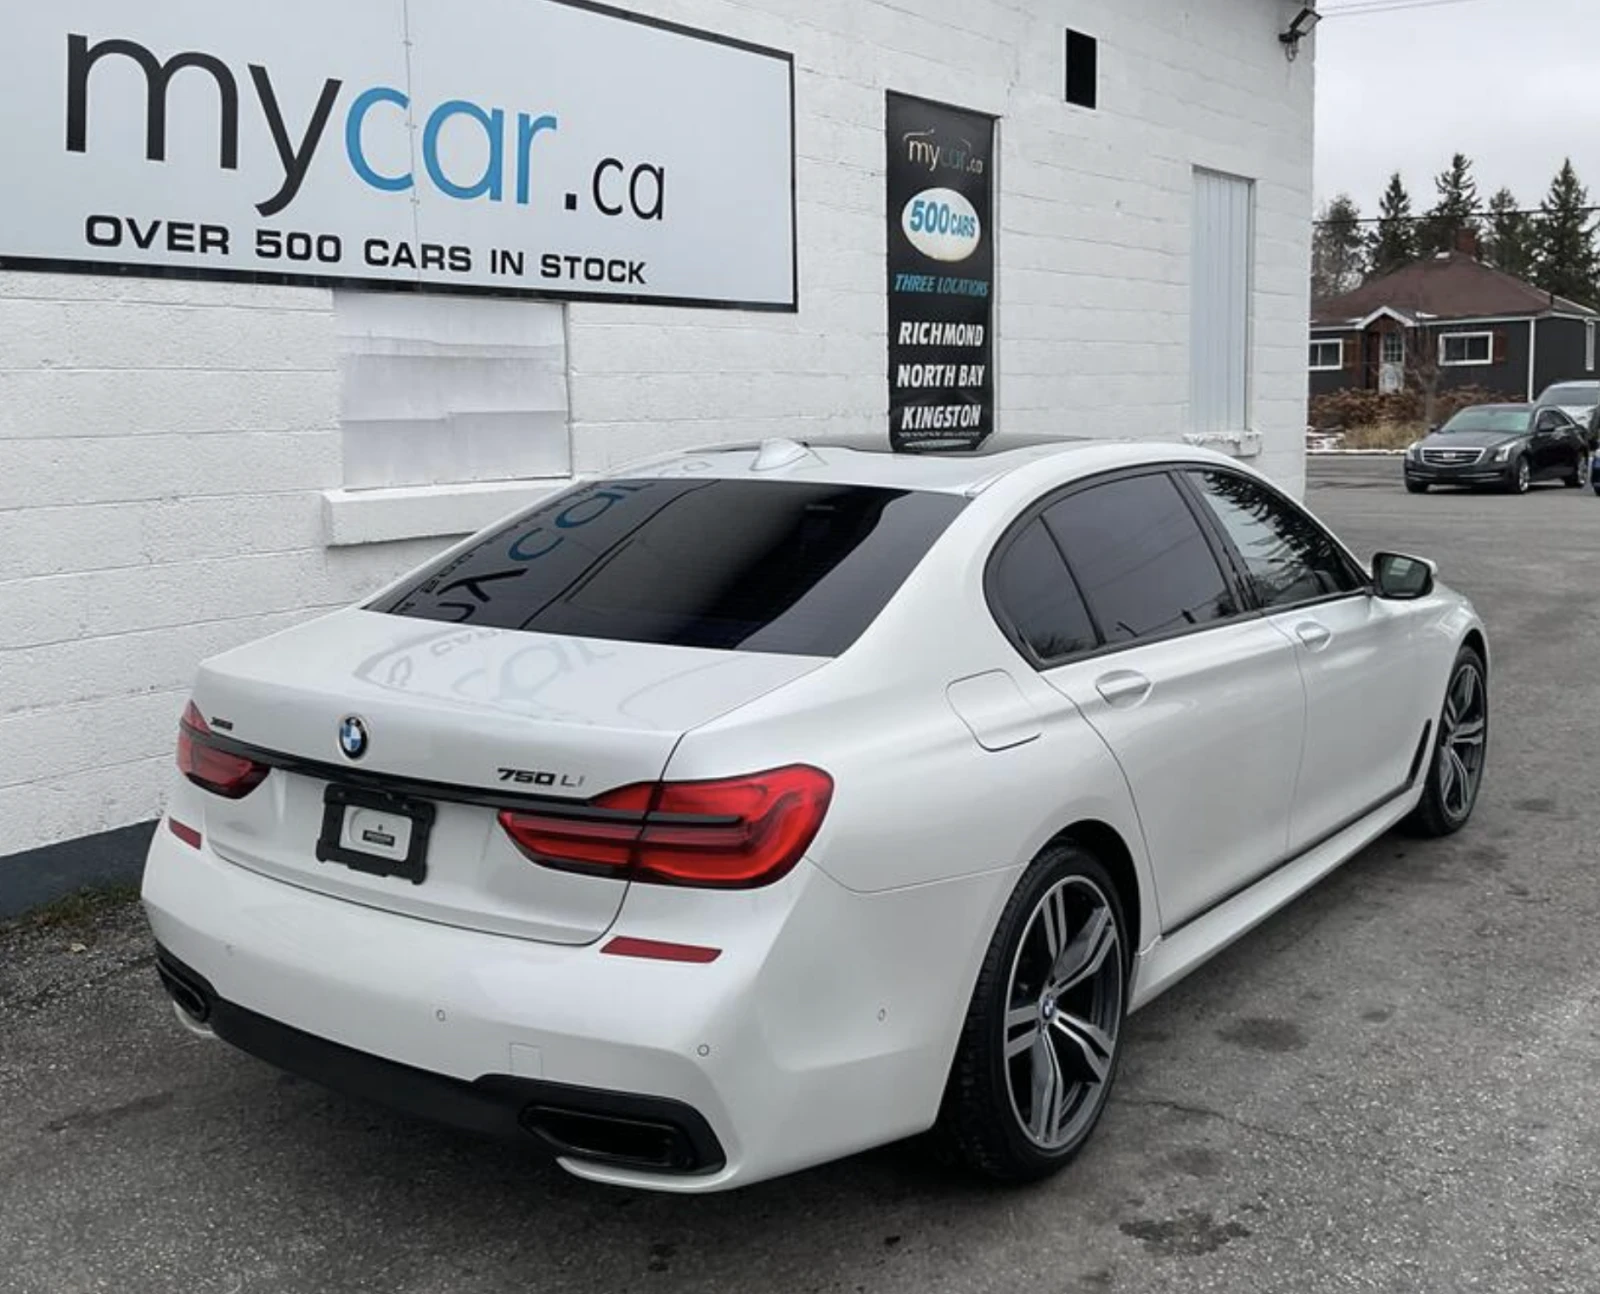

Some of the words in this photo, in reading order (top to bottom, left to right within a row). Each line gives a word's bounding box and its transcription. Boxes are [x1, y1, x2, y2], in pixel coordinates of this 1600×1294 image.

[66, 33, 666, 221] mycar.ca
[909, 200, 949, 235] 500
[950, 213, 976, 239] CARS
[85, 214, 231, 256] OVER
[255, 230, 342, 264] 500
[364, 239, 473, 273] CARS
[490, 250, 524, 277] IN
[540, 254, 647, 285] STOCK
[894, 273, 936, 293] THREE
[898, 321, 984, 347] RICHMOND
[896, 363, 957, 388] NORTH
[957, 364, 986, 387] BAY
[901, 404, 982, 430] KINGSTON
[497, 767, 556, 786] 750
